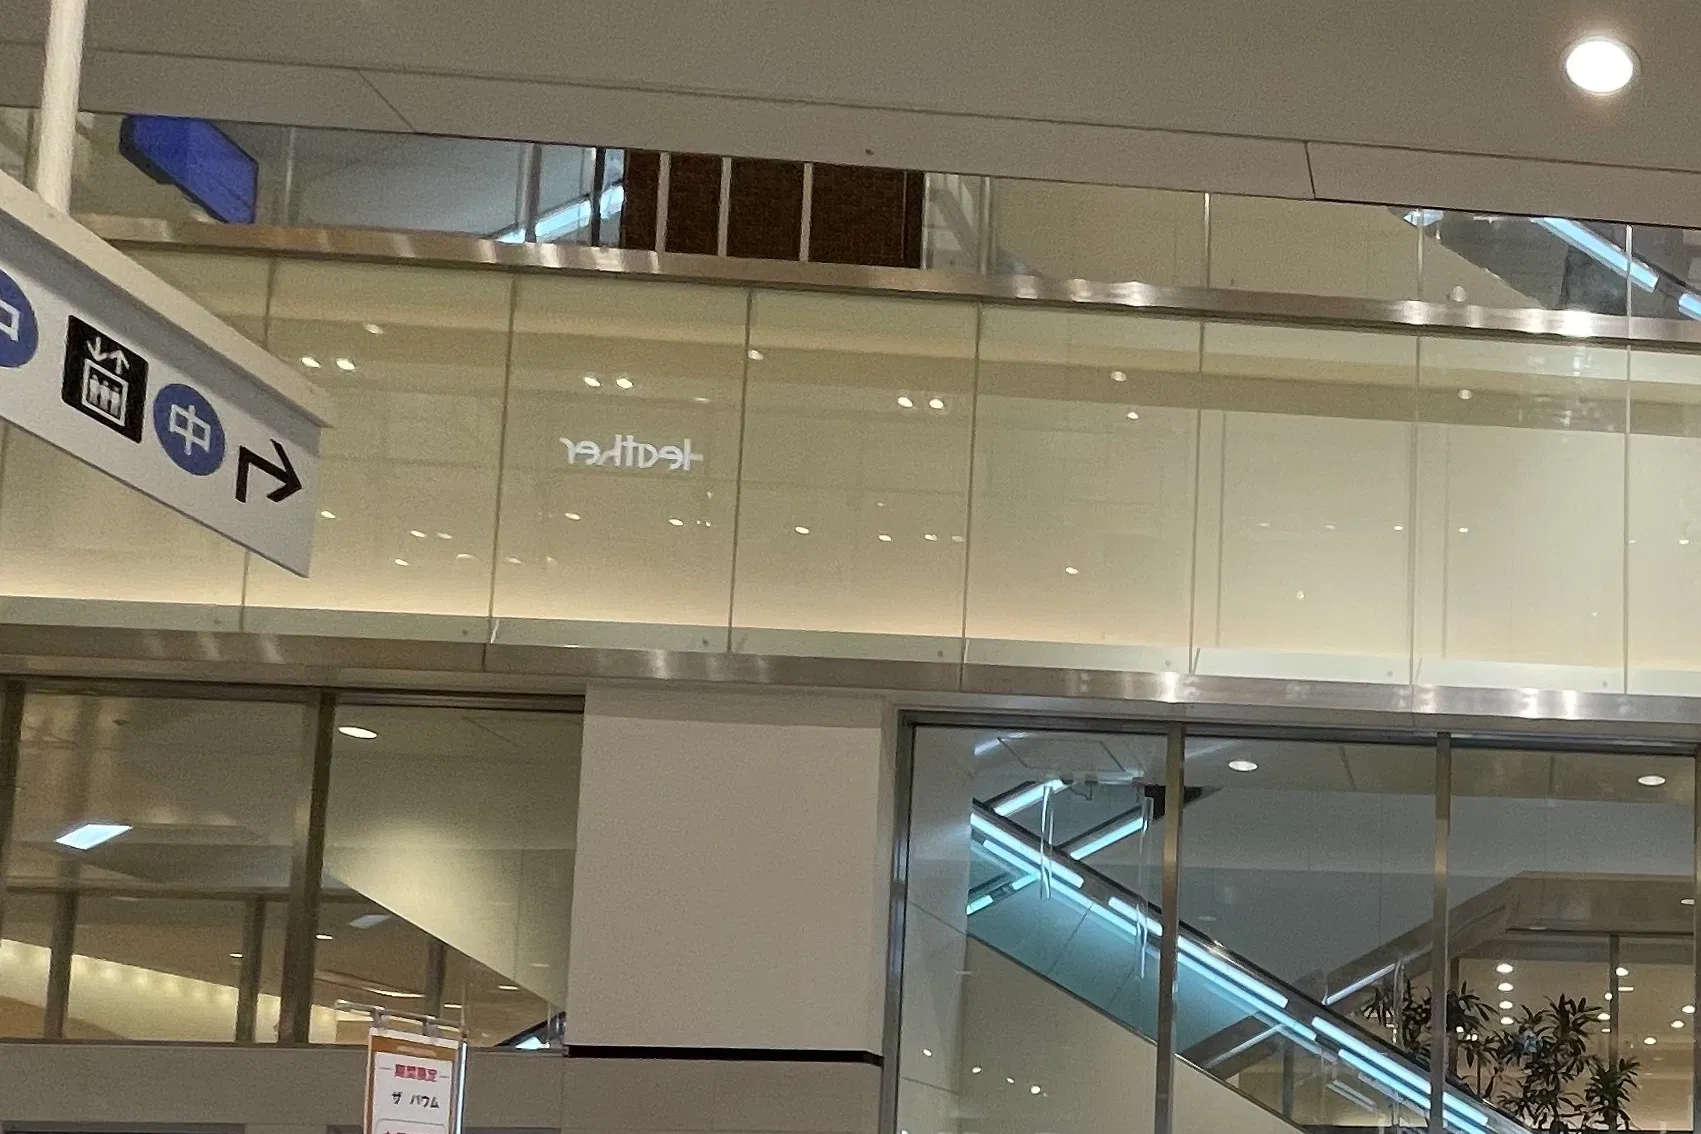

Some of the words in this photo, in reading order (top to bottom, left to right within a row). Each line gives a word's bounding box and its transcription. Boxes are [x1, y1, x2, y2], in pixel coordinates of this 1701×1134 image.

[169, 402, 212, 456] 中
[409, 1094, 440, 1109] バウム
